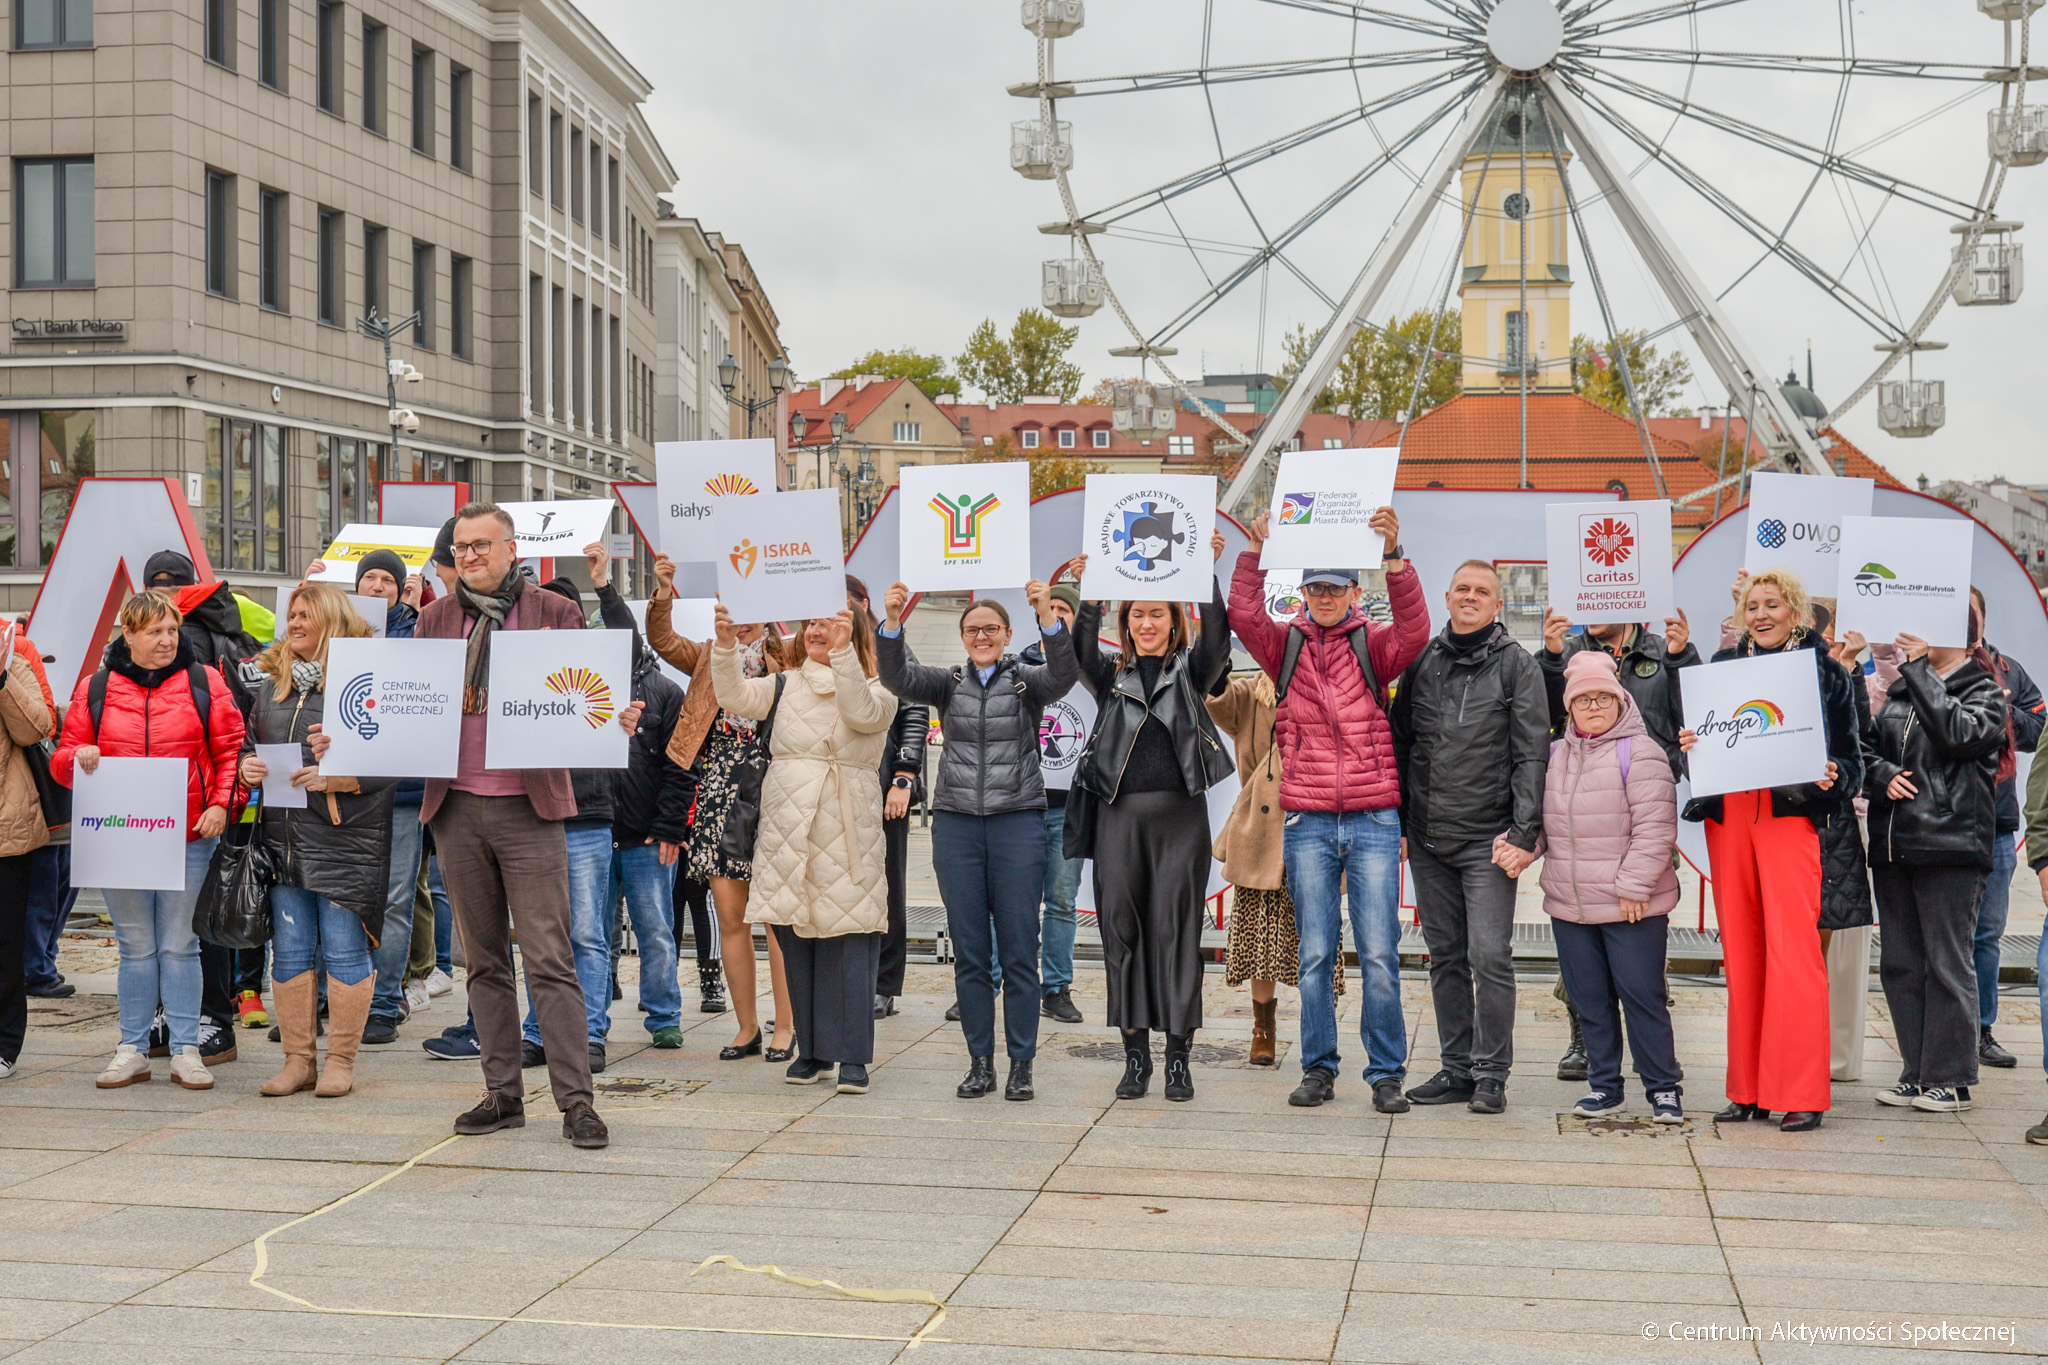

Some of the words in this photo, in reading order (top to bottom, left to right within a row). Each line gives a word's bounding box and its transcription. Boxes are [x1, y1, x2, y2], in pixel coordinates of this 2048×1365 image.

[44, 319, 79, 333] Bank
[81, 318, 123, 333] Pekao
[192, 479, 198, 498] 7
[1318, 491, 1357, 500] Federacja
[1316, 499, 1361, 509] Organizacji
[670, 502, 713, 520] Białys
[1101, 511, 1116, 555] KRAJOWE
[1114, 490, 1184, 510] TOWARZYSTWO
[1183, 512, 1198, 557] AUTYZMU
[1313, 516, 1339, 524] Miasta
[1340, 515, 1371, 525] Białysto
[514, 531, 574, 542] RAMPOLINA
[763, 542, 812, 558] ISKRA
[789, 559, 820, 567] Wspierania
[765, 567, 787, 575] Rodziny
[790, 565, 831, 574] Społeczeństwa
[1115, 565, 1137, 581] Oddział
[1144, 567, 1181, 583] Białymstoku
[1586, 570, 1634, 583] caritas
[1924, 585, 1956, 593] Białystok
[1577, 590, 1645, 601] ARCHIDIECEZJI
[1576, 601, 1647, 611] BIAŁOSTOCKIEJ
[381, 681, 431, 691] CENTRUM
[380, 692, 449, 704] AKTYWNOŚCI
[379, 704, 444, 716] SPOŁECZNEJ
[502, 698, 577, 720] Białystok
[1696, 709, 1759, 749] droga
[1778, 728, 1796, 736] pomocy
[80, 814, 176, 833] mydlainnych
